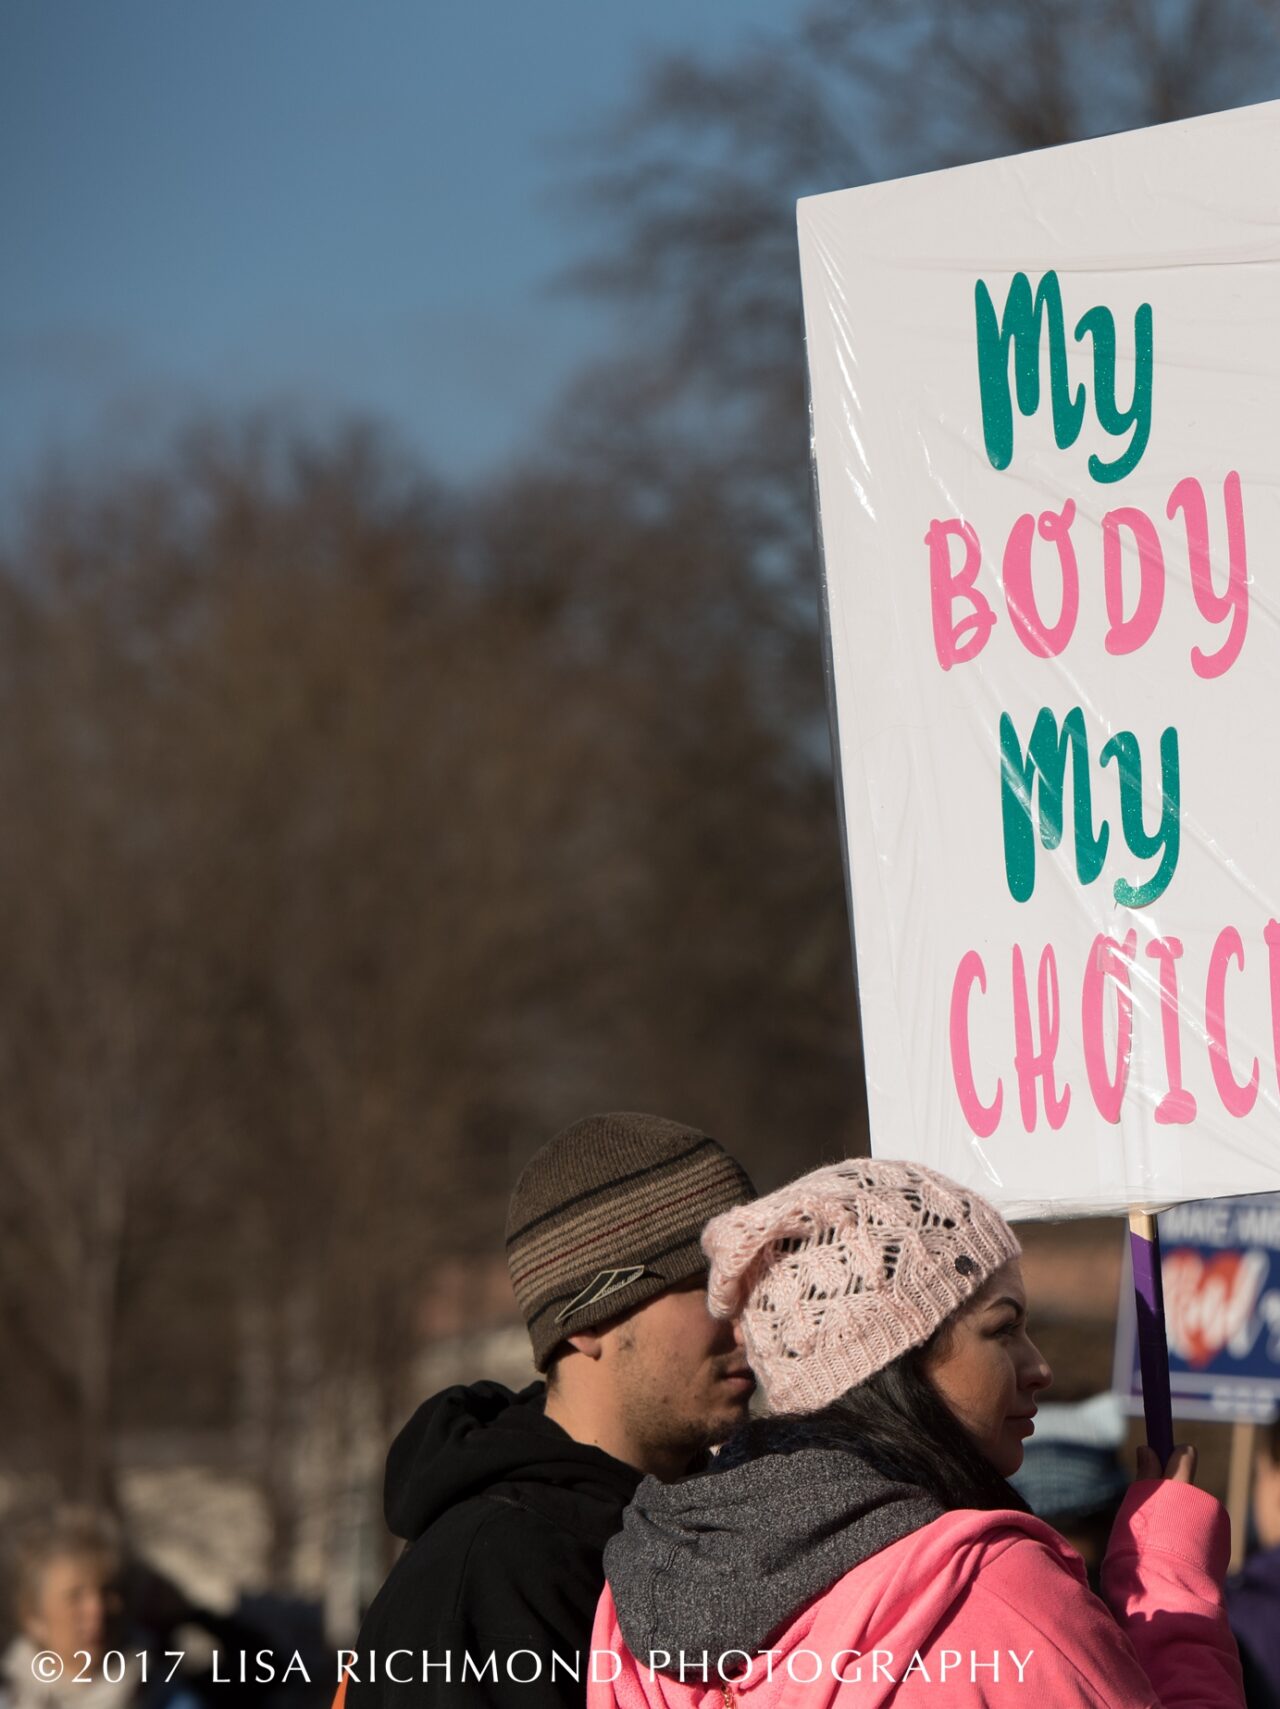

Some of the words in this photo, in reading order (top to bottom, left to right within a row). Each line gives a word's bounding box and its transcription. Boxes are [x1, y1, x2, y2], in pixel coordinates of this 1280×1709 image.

[975, 270, 1153, 484] My
[924, 470, 1248, 680] BODY
[1000, 706, 1181, 908] My
